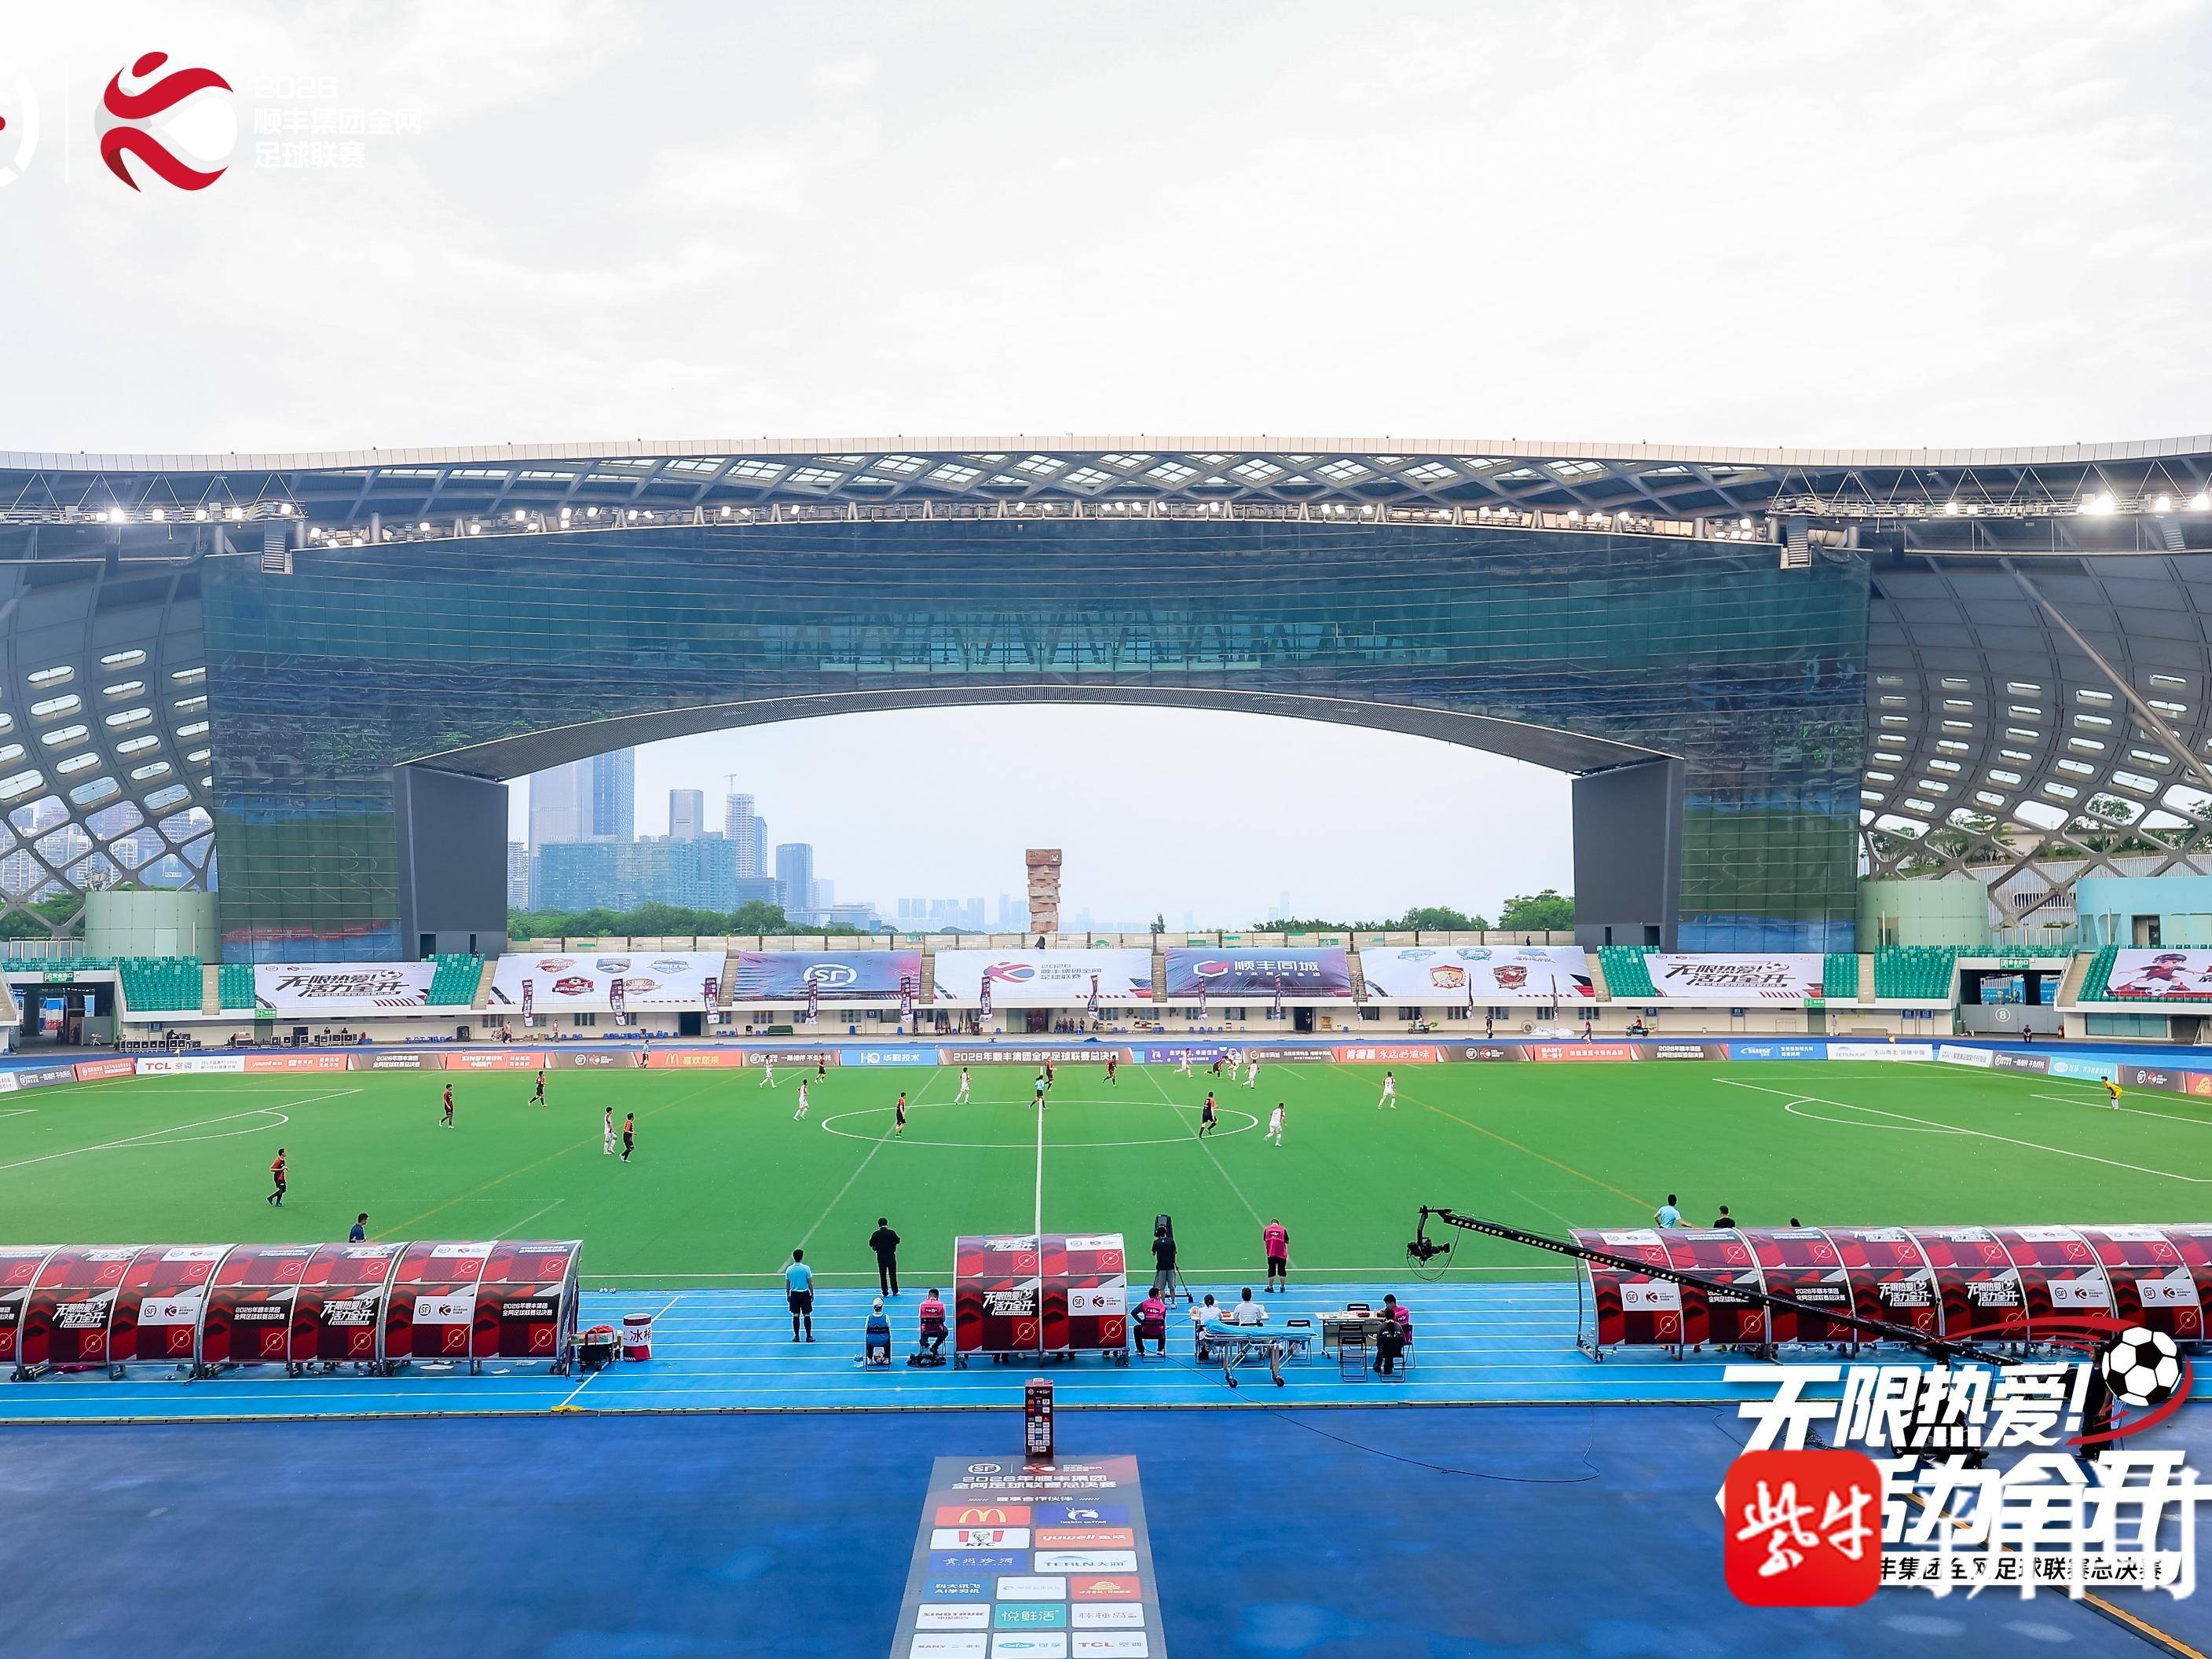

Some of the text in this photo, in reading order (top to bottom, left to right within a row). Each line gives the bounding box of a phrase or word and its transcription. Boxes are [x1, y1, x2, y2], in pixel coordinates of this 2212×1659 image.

[1234, 961, 1320, 972] 顺丰同城
[1686, 972, 1796, 986] 活力全开
[298, 981, 409, 998] 活力全开
[1999, 1011, 2006, 1020] 8
[683, 1056, 719, 1064] 喜欢您来
[1346, 1049, 1429, 1060] 肯德基 永远好滋味
[1890, 1291, 1932, 1307] 活力全开
[1978, 1291, 2020, 1307] 活力全开
[991, 1300, 1035, 1317] 活力全开
[60, 1312, 106, 1328] 活力全开
[328, 1309, 374, 1326] 活力全开
[1002, 1610, 1055, 1621] 悦鲜活
